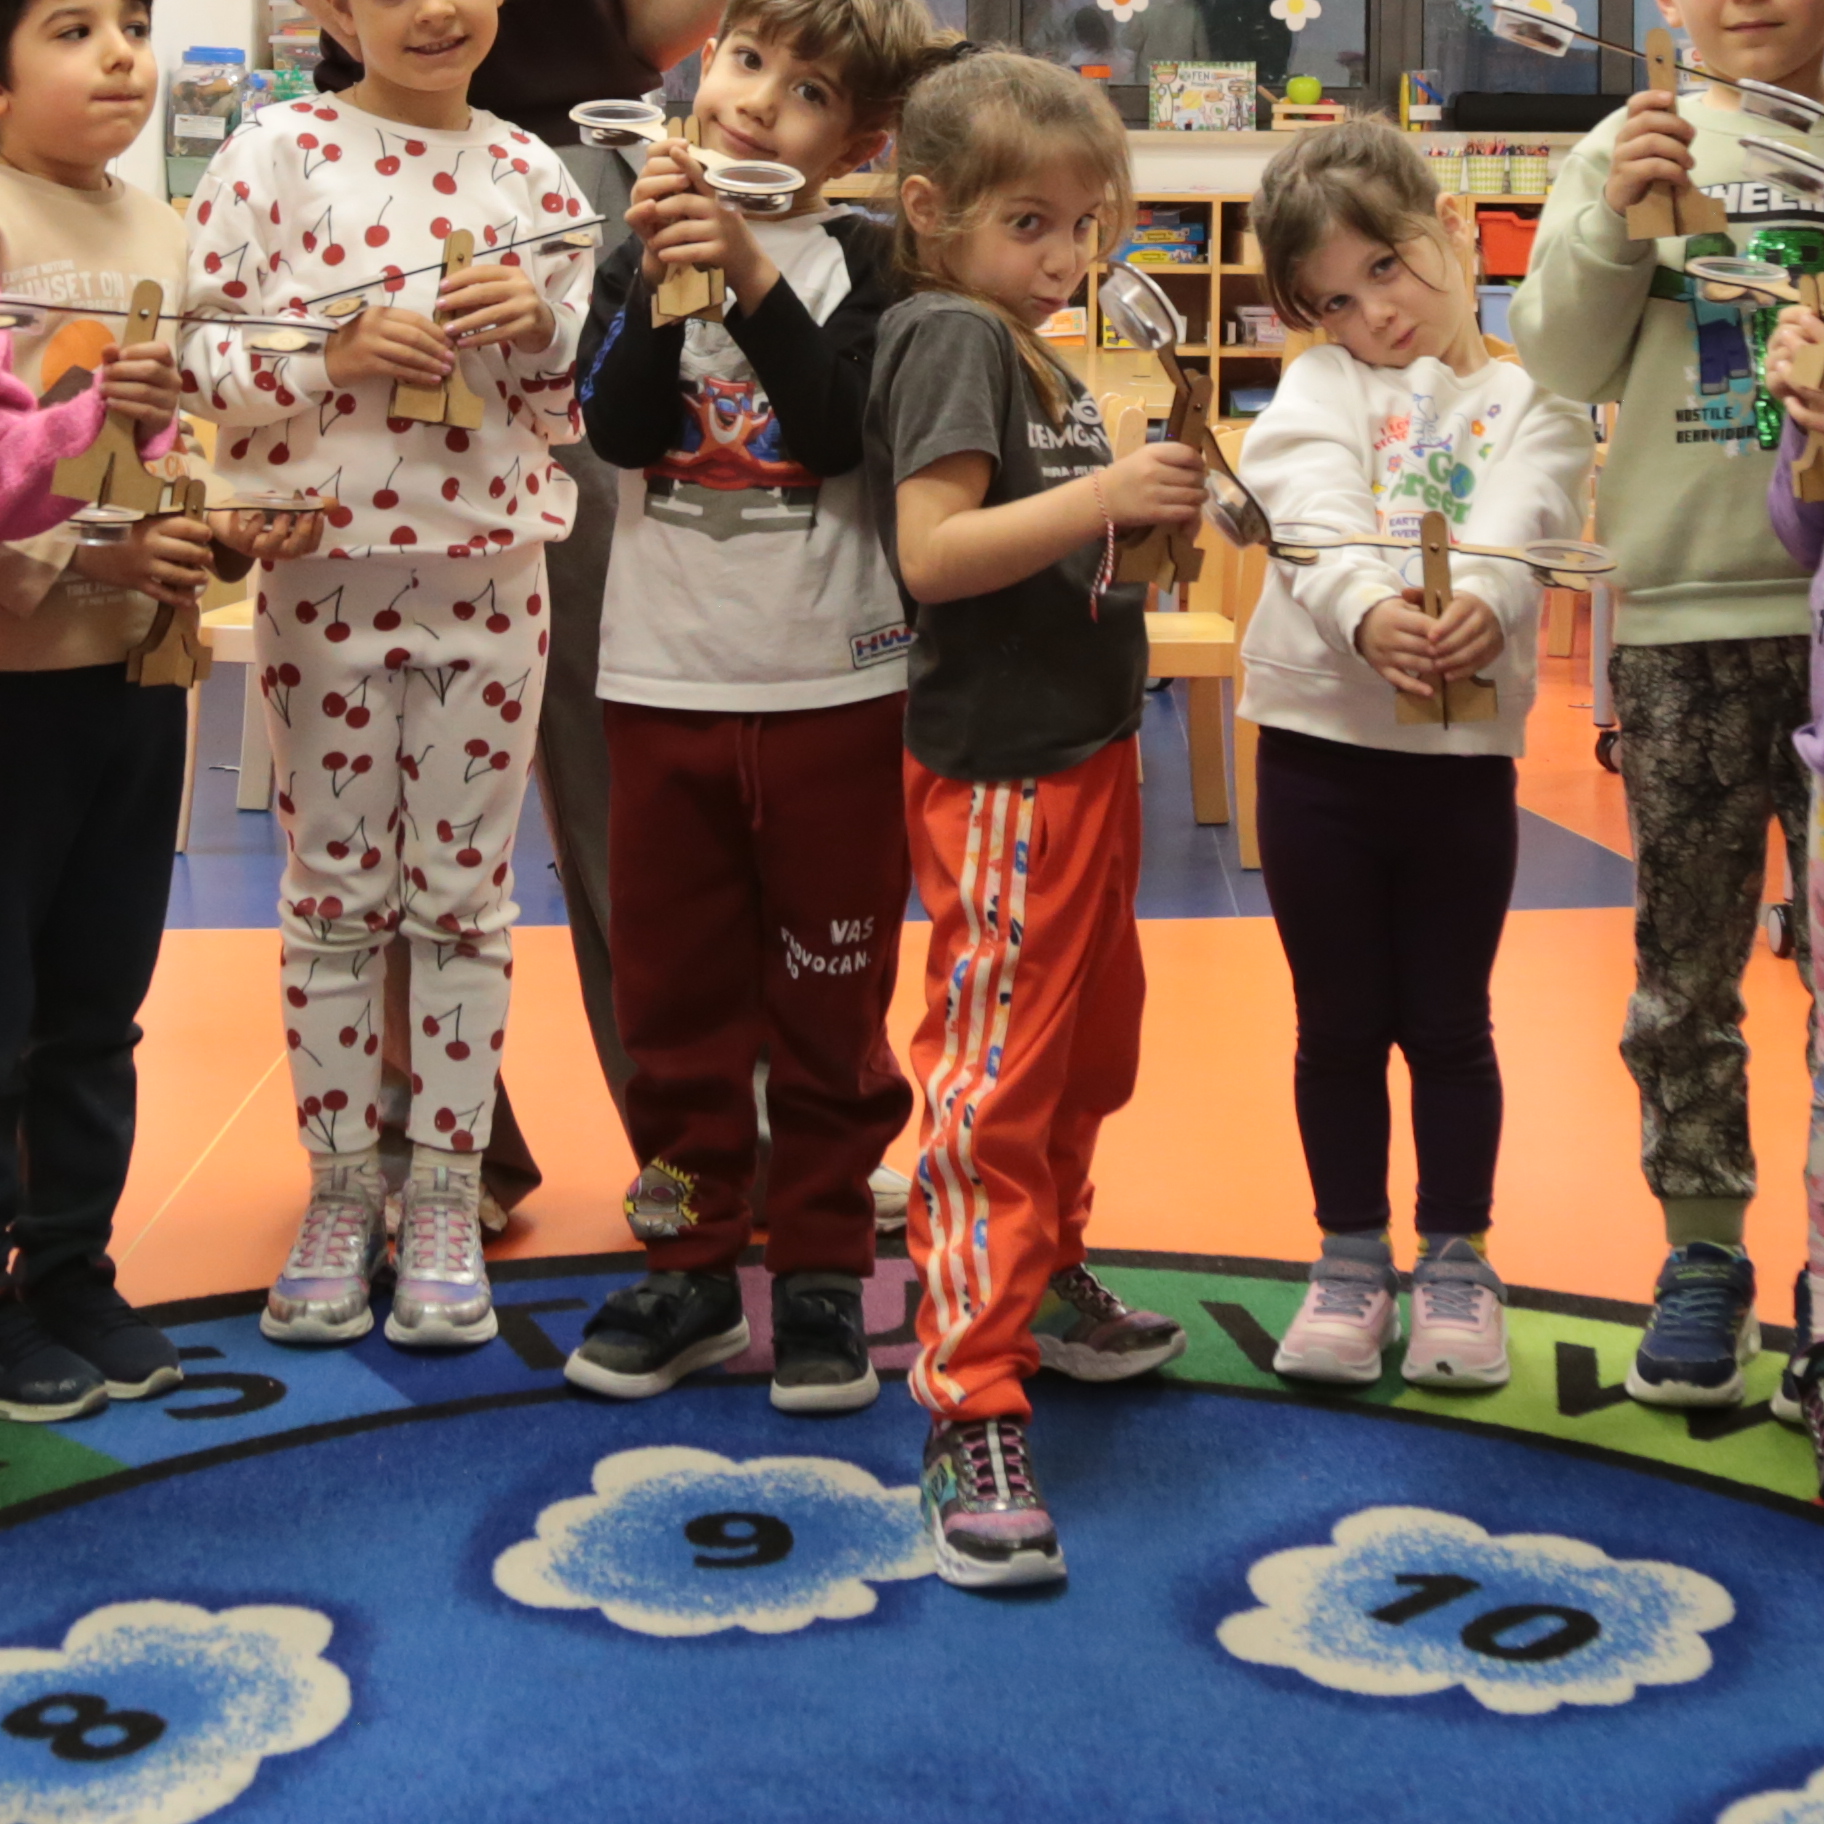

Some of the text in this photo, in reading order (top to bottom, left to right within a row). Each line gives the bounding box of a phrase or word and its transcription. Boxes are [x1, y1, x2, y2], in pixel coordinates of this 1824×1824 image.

[99, 271, 126, 298] ON
[855, 626, 912, 656] HW
[830, 915, 875, 946] VAS
[684, 1512, 794, 1569] 9
[1363, 1573, 1601, 1665] 10
[0, 1693, 167, 1762] 8
